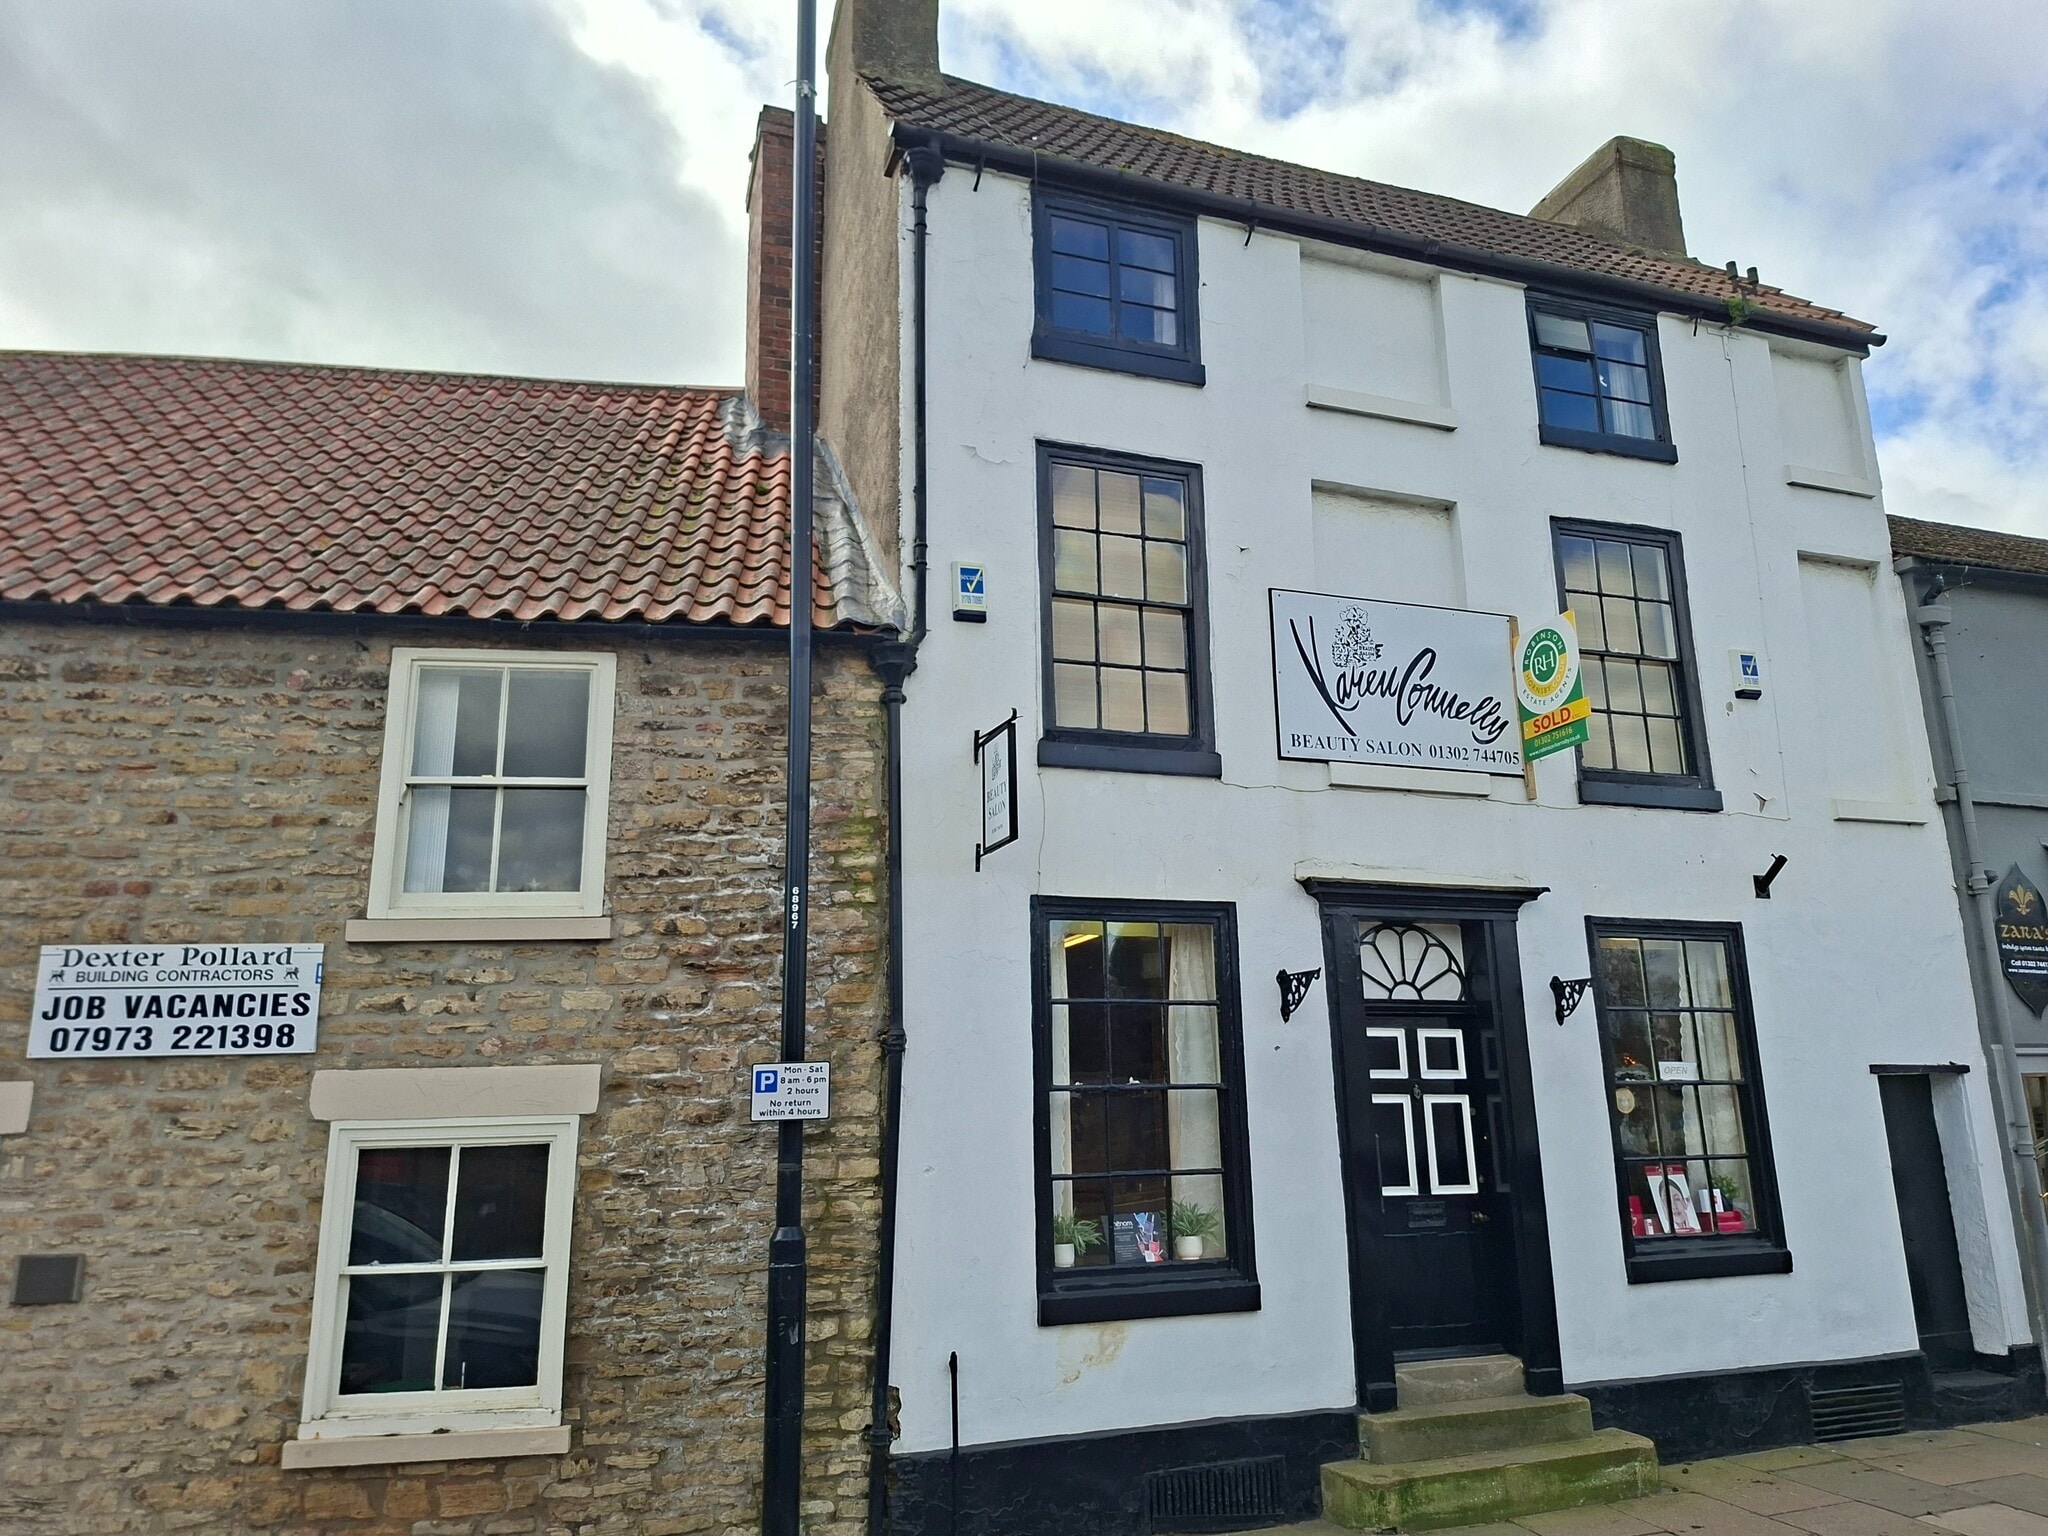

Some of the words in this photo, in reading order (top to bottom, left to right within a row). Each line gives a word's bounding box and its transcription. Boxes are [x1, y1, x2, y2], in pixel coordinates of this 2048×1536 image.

[1524, 631, 1563, 665] ROBINSON
[1534, 650, 1555, 675] RH
[1289, 615, 1399, 736] Karen
[1397, 648, 1510, 744] Connelly
[1522, 689, 1546, 705] ESTATE
[1550, 667, 1572, 703] AGENTS
[1533, 707, 1571, 733] SOLD
[1290, 733, 1361, 752] BEAUTY
[1366, 739, 1423, 758] SALON
[1429, 743, 1470, 761] 01302
[1473, 748, 1520, 766] 744705
[1534, 734, 1551, 747] 01302
[987, 781, 1007, 803] BEAUTY
[988, 800, 1006, 820] SALON
[791, 886, 800, 929] 68967
[60, 947, 165, 968] Dexter
[180, 946, 293, 967] Pollard
[75, 970, 149, 983] BUILDING
[156, 968, 274, 982] CONTRACTORS
[41, 995, 106, 1021] JOB
[125, 992, 311, 1019] VACANCIES
[50, 1026, 153, 1052] 07973
[170, 1023, 295, 1050] 221398
[780, 1076, 786, 1084] 8
[806, 1075, 812, 1083] 6
[784, 1066, 802, 1074] Mon
[809, 1065, 823, 1073] Sat
[1663, 1066, 1688, 1075] OPEN
[760, 1072, 775, 1091] P
[786, 1087, 793, 1095] 2
[759, 1109, 786, 1117] within
